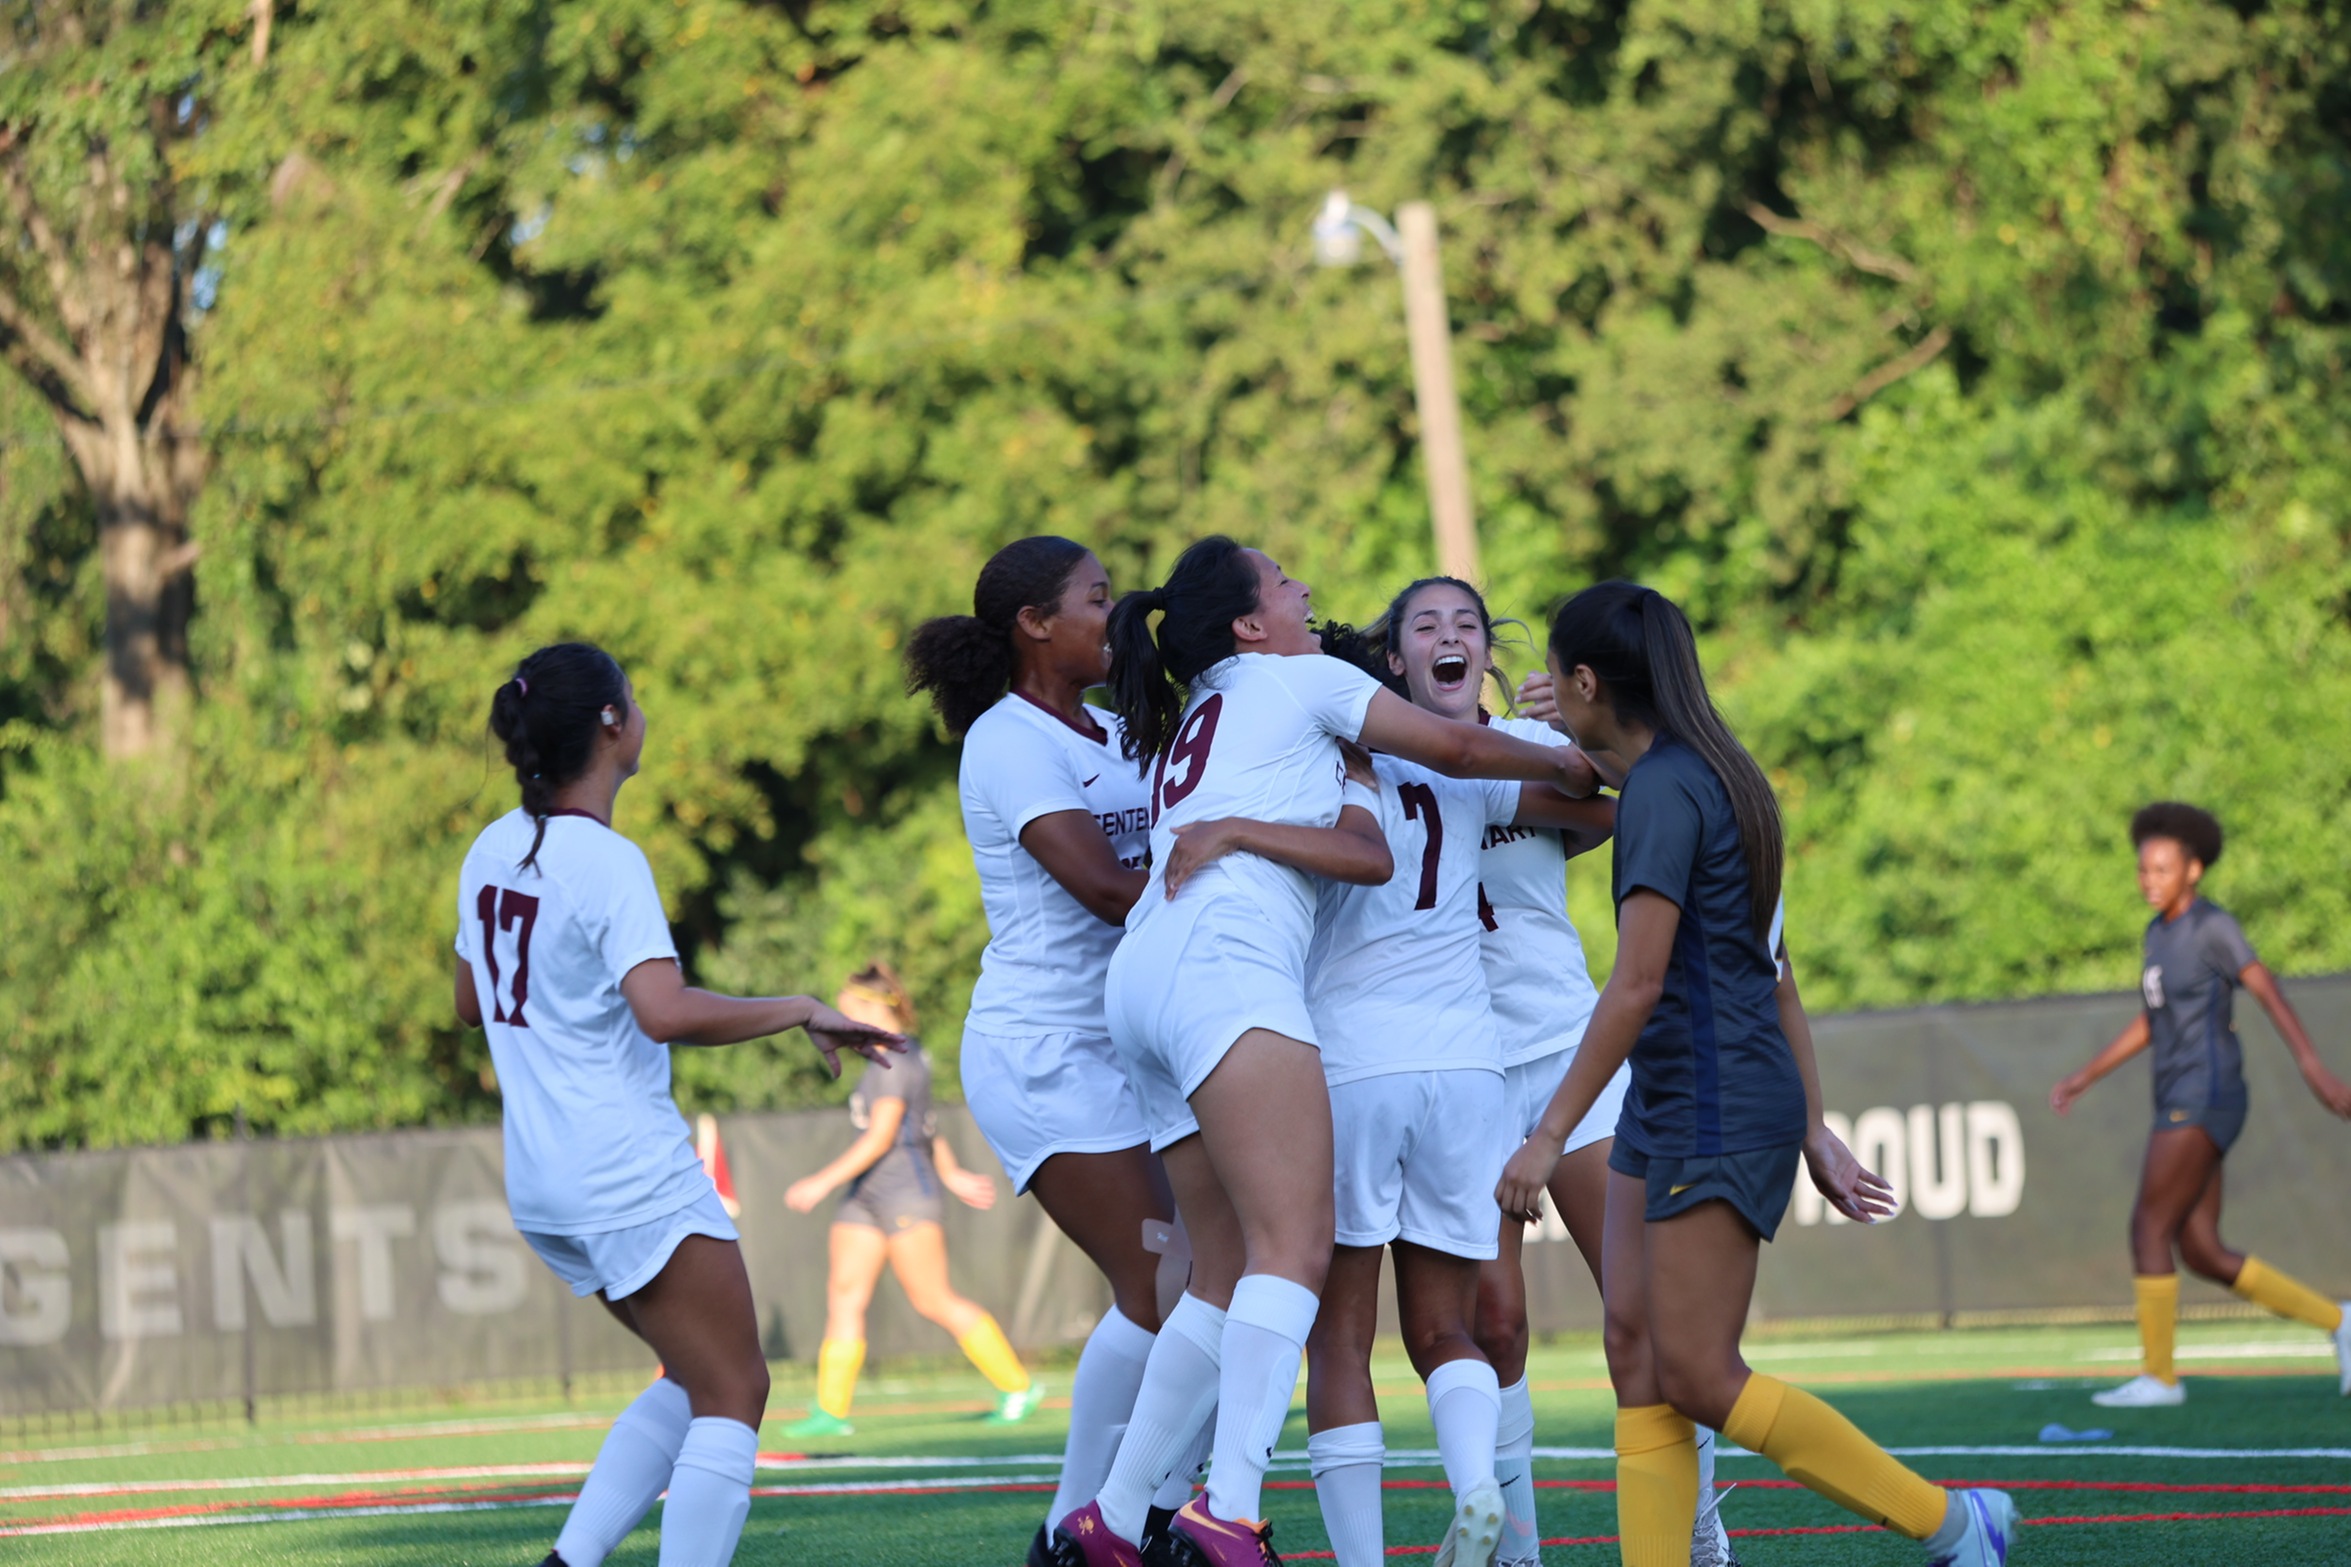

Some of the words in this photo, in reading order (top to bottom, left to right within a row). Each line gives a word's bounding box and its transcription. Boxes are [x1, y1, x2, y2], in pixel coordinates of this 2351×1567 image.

[1397, 781, 1443, 911] 7
[477, 883, 539, 1028] 17
[0, 1199, 528, 1346] GENTS
